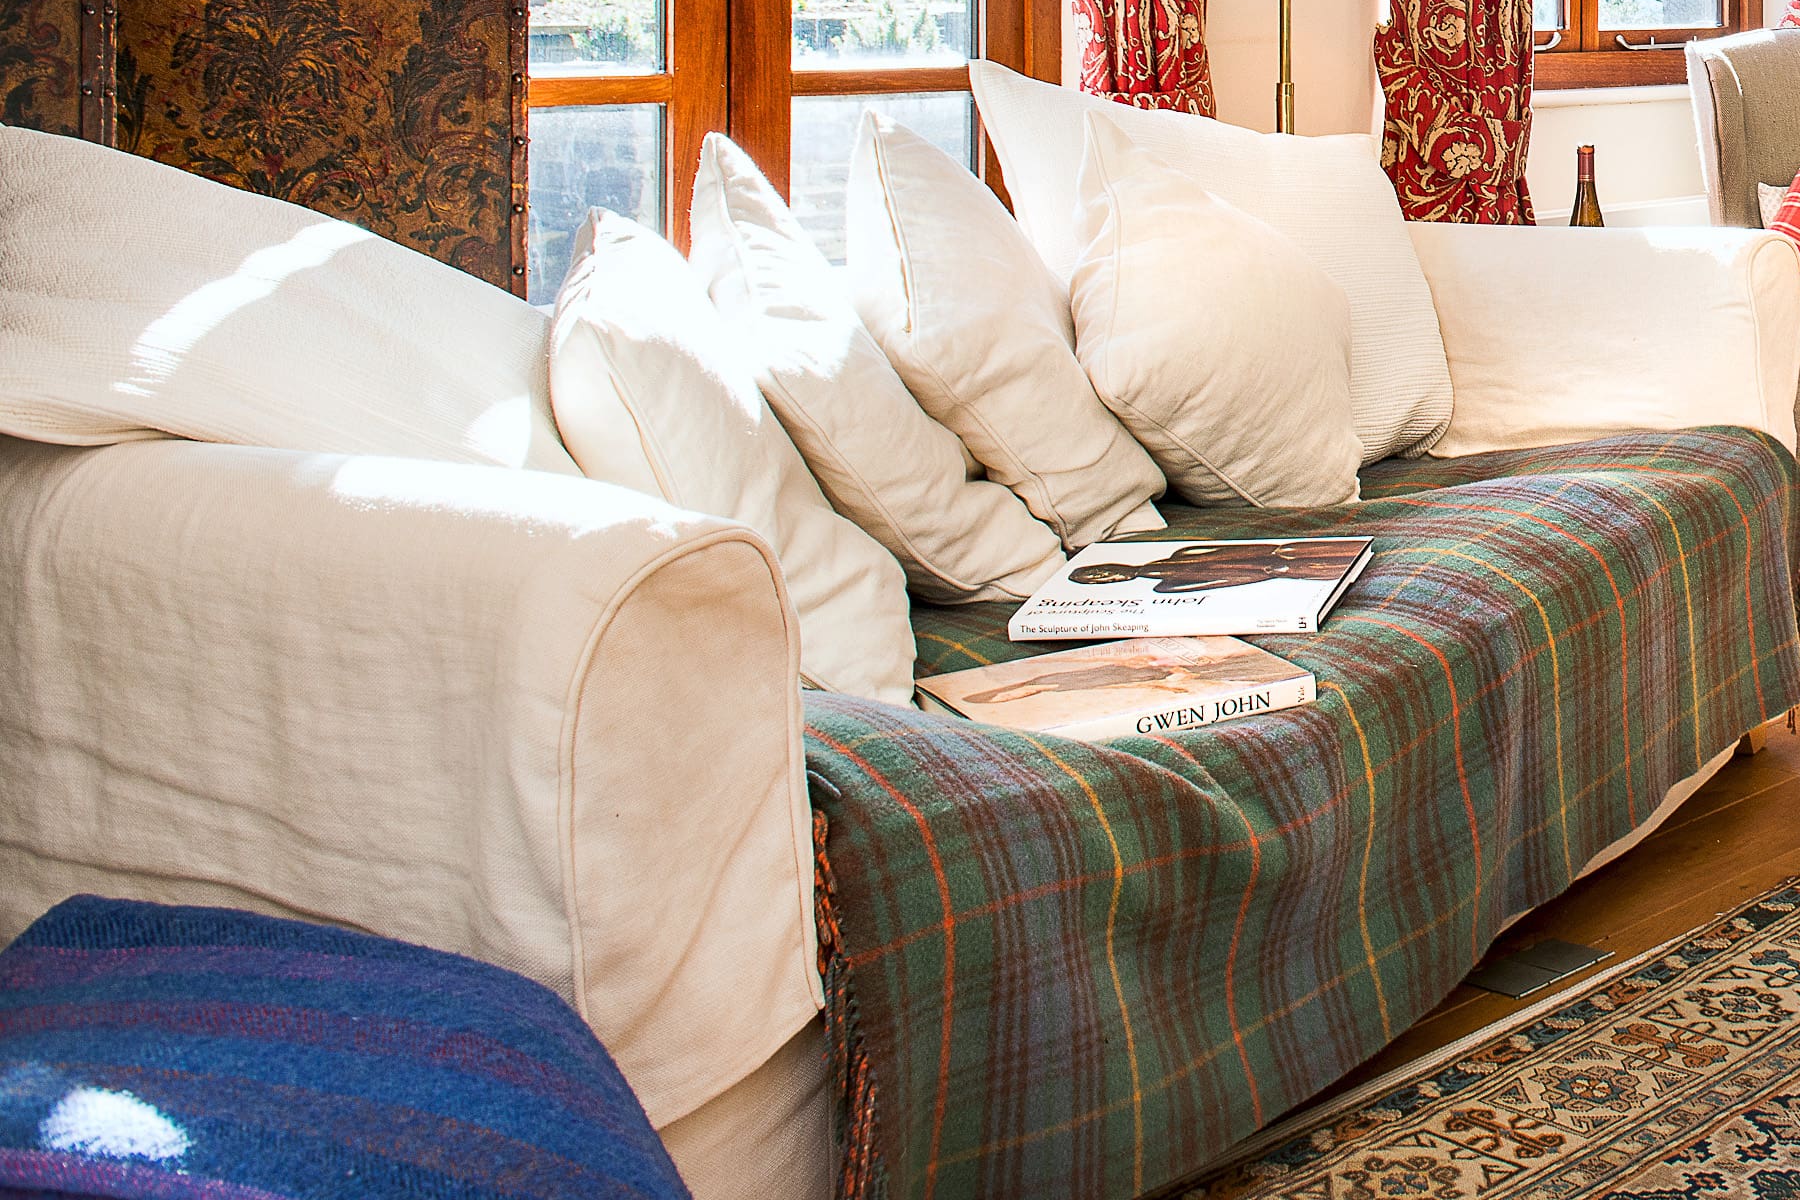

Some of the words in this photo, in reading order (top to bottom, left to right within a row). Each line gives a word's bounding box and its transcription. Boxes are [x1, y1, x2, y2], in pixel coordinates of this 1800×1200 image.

[1036, 598, 1144, 608] Skeaping
[1152, 595, 1208, 606] John
[1020, 624, 1037, 633] The
[1039, 624, 1078, 635] Sculpture
[1080, 623, 1089, 632] of
[1090, 623, 1110, 635] John
[1112, 622, 1149, 632] Skeaping
[1136, 705, 1204, 734] GWEN
[1211, 691, 1271, 724] JOHN
